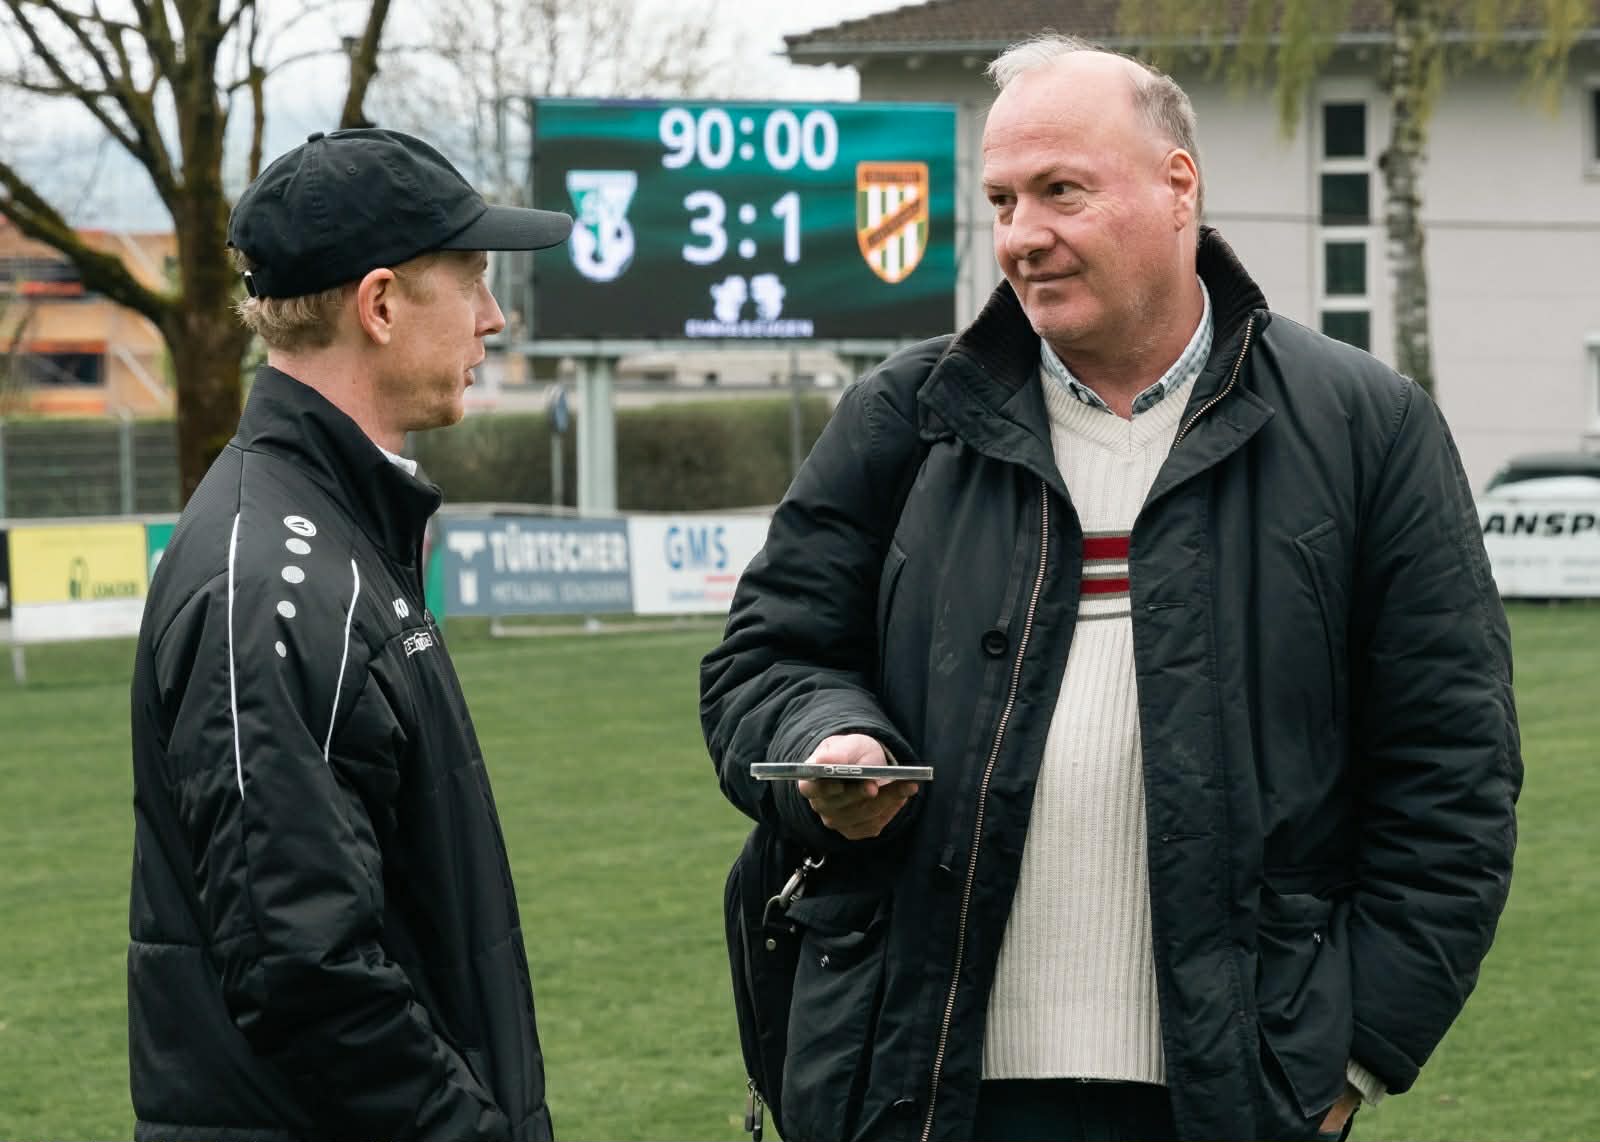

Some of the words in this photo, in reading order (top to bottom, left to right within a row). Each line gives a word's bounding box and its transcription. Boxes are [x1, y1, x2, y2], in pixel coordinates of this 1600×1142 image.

[659, 108, 839, 171] 90:00
[681, 190, 802, 265] 3:1
[490, 521, 627, 573] TÜRTSCHER
[664, 525, 728, 570] GMS
[1483, 512, 1600, 535] ANSP
